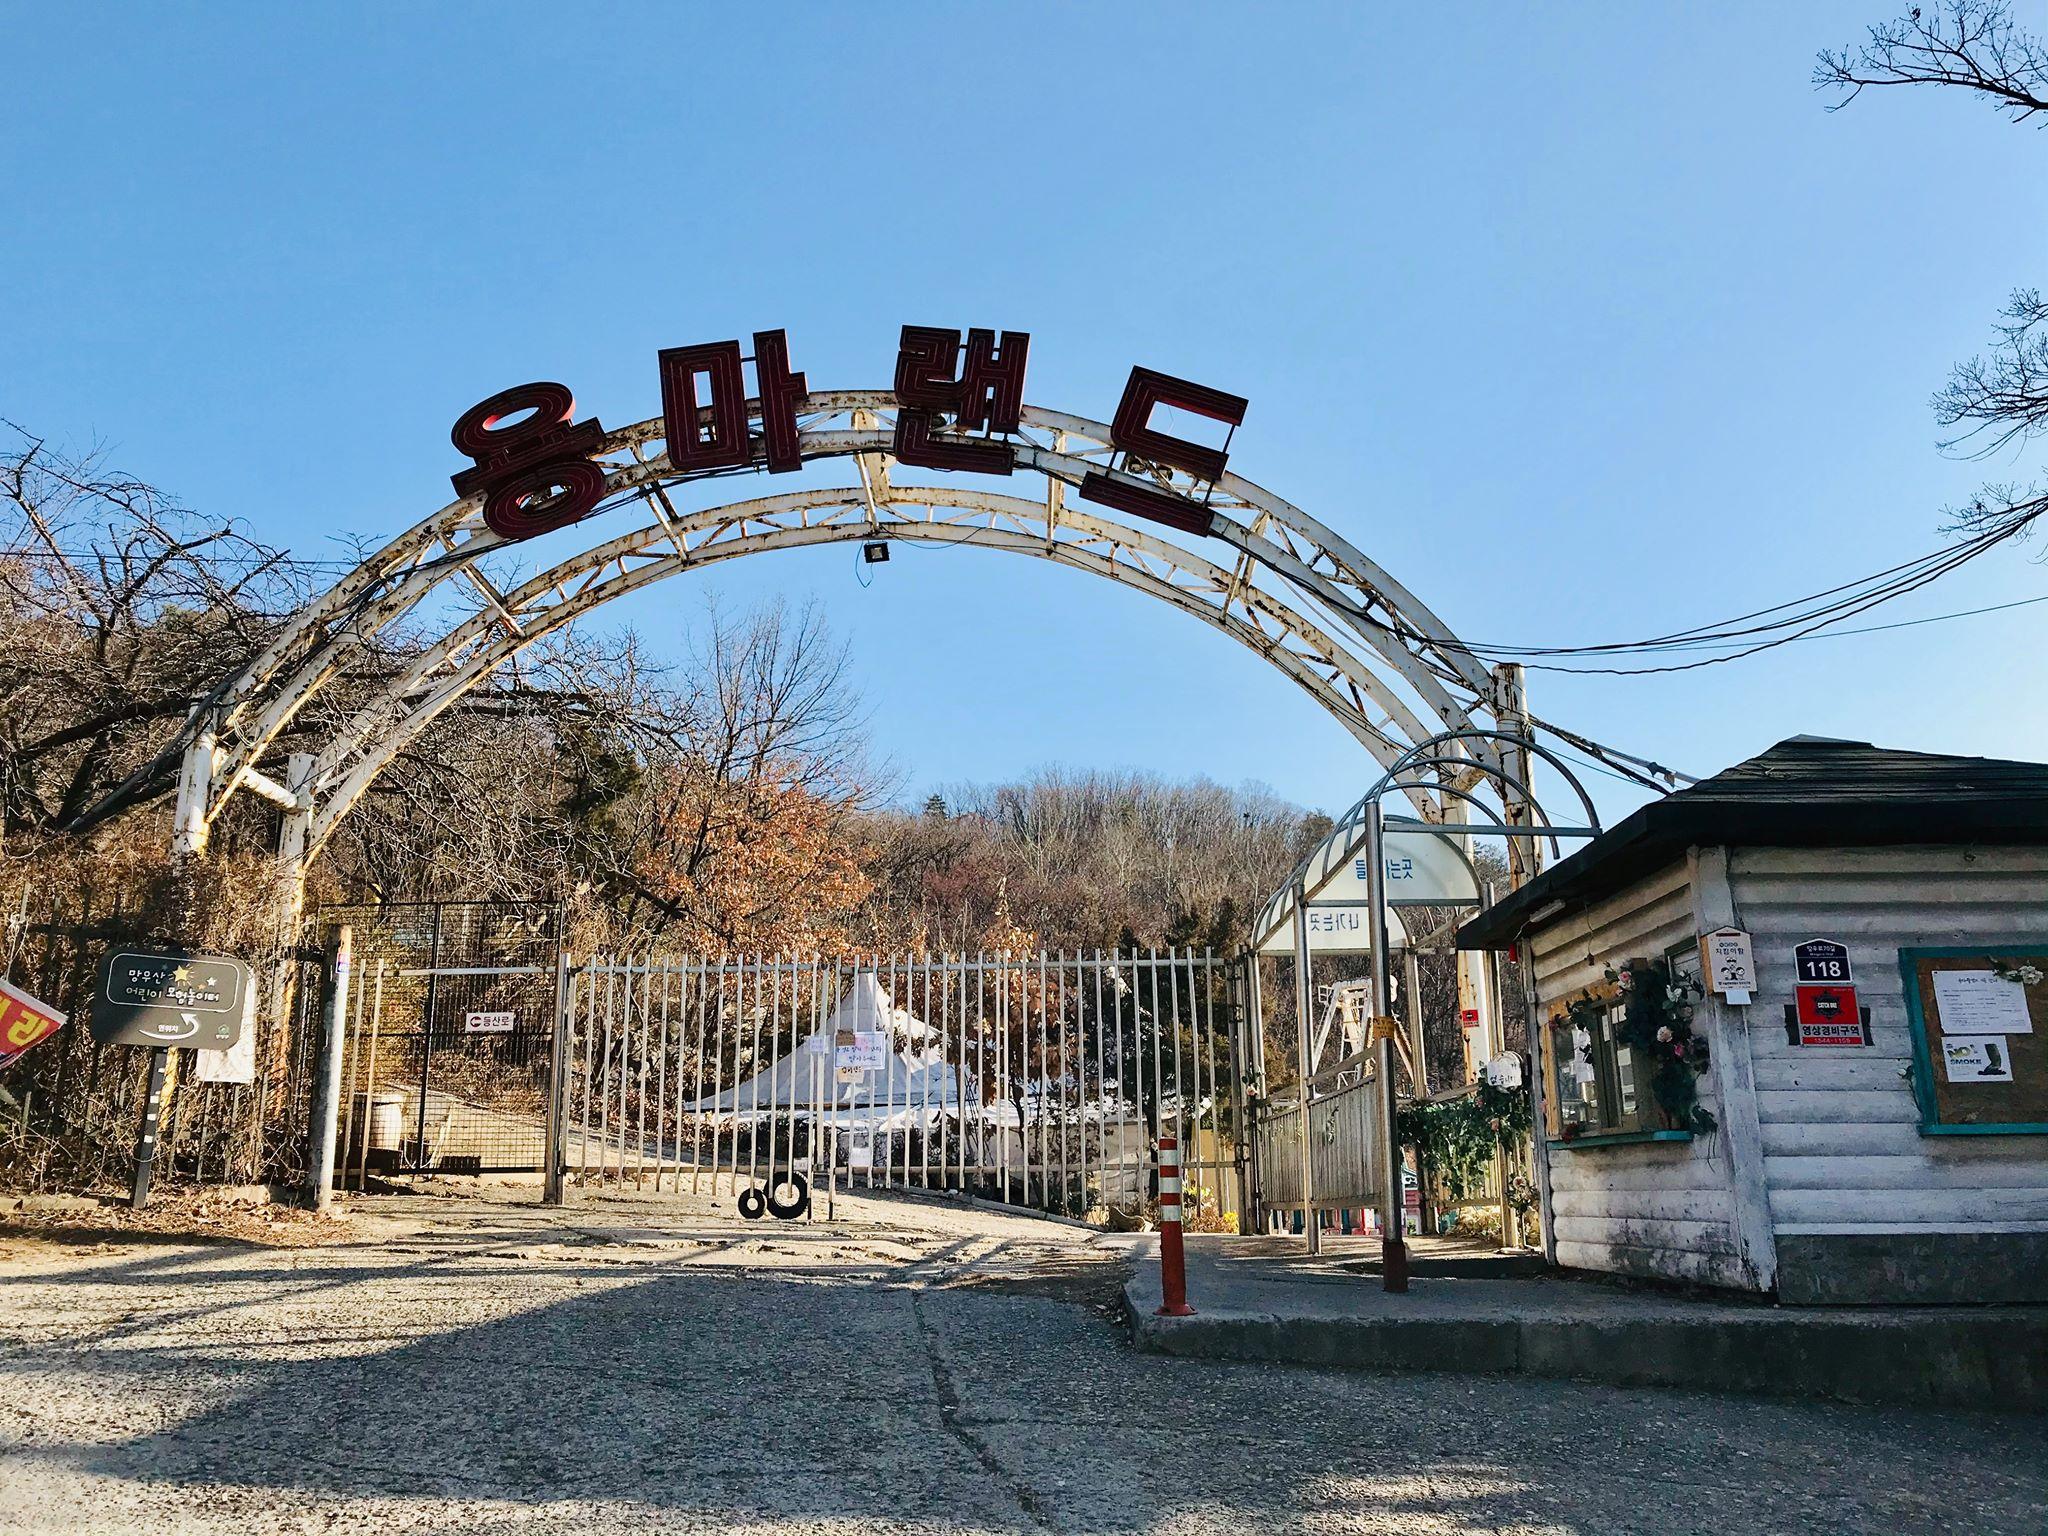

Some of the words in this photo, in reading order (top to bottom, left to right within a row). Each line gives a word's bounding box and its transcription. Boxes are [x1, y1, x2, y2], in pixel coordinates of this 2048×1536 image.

[451, 328, 1249, 537] 용마랜드
[1356, 859, 1413, 880] 들는곳
[129, 969, 167, 984] 망우산
[1807, 961, 1841, 977] 118
[126, 987, 162, 1001] 어린이
[166, 987, 220, 1005] 모험놀이터
[483, 1016, 509, 1027] 등산로
[1802, 1025, 1860, 1036] 영상경비구역
